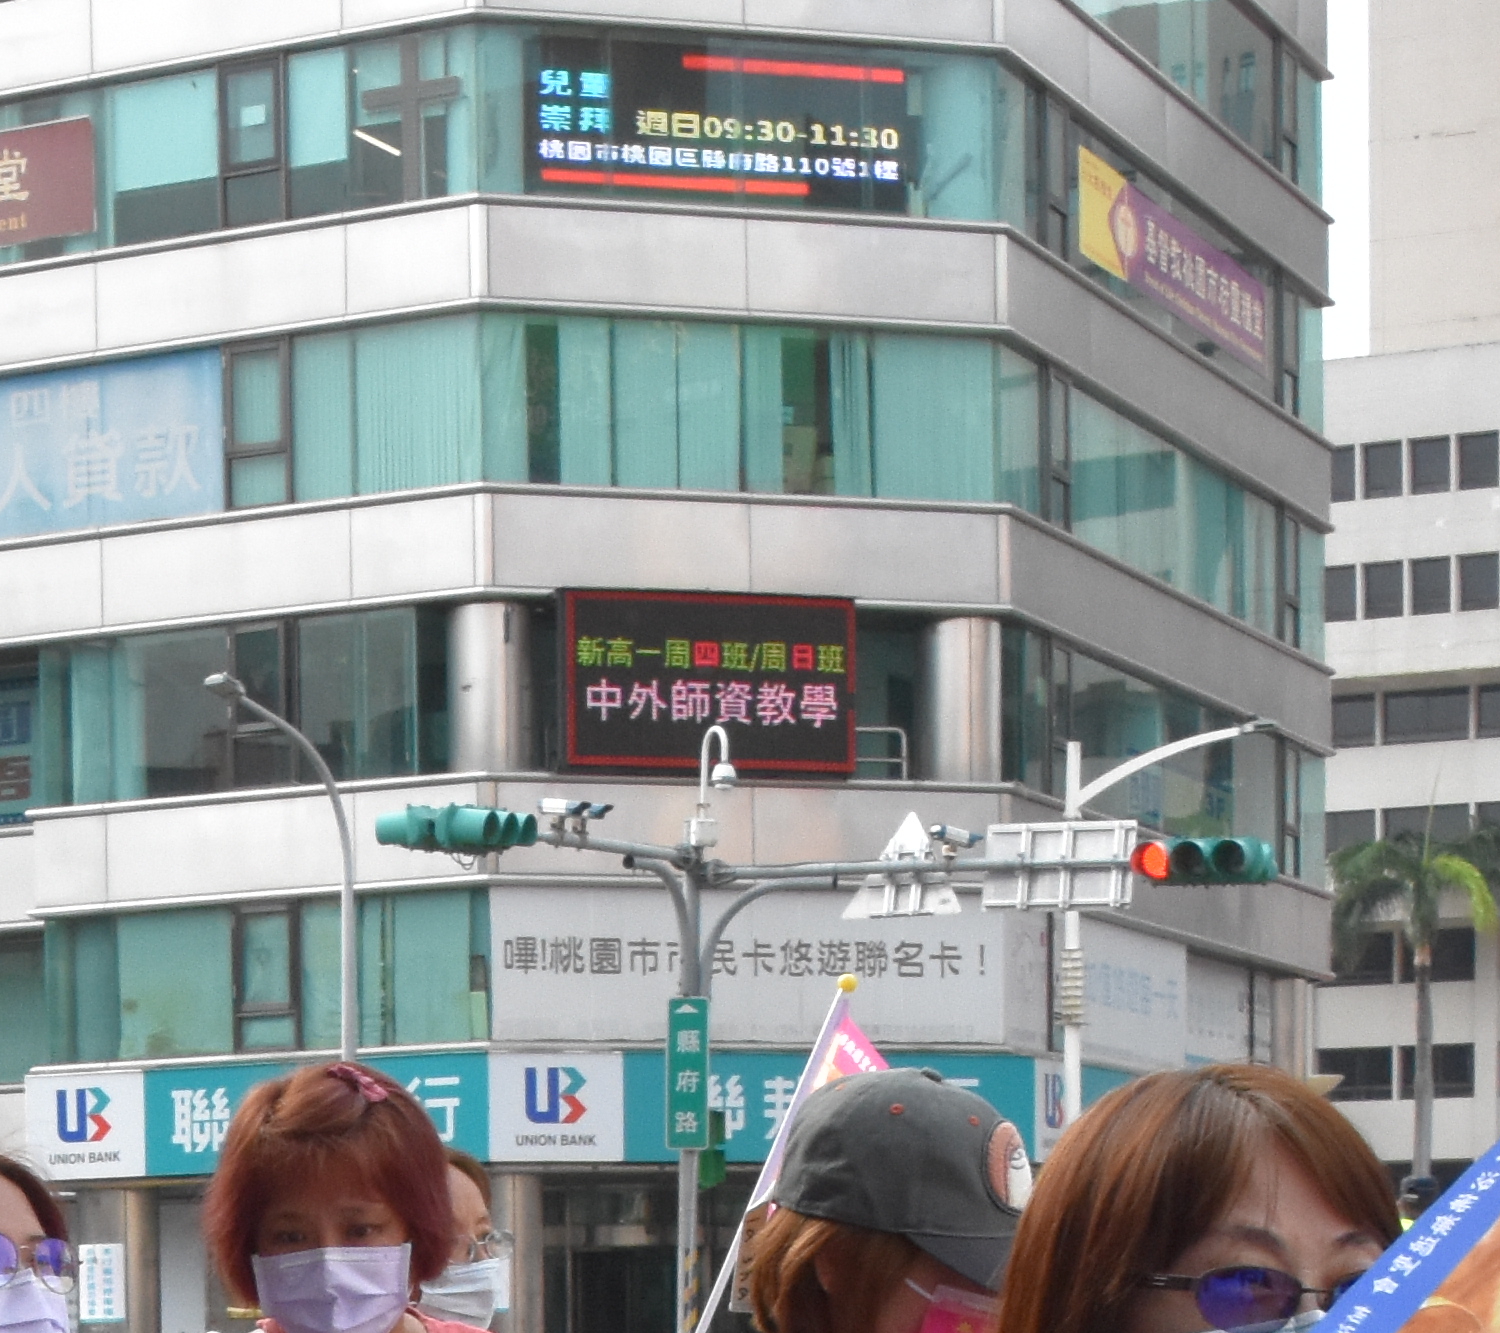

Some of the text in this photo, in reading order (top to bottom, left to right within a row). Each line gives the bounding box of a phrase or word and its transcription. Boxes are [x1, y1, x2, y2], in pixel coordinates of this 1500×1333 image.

[584, 677, 840, 729] 中外師資教學
[674, 1028, 702, 1135] 縣府路
[516, 1134, 597, 1146] UNION BANK
[48, 1152, 121, 1165] UNION BANK
